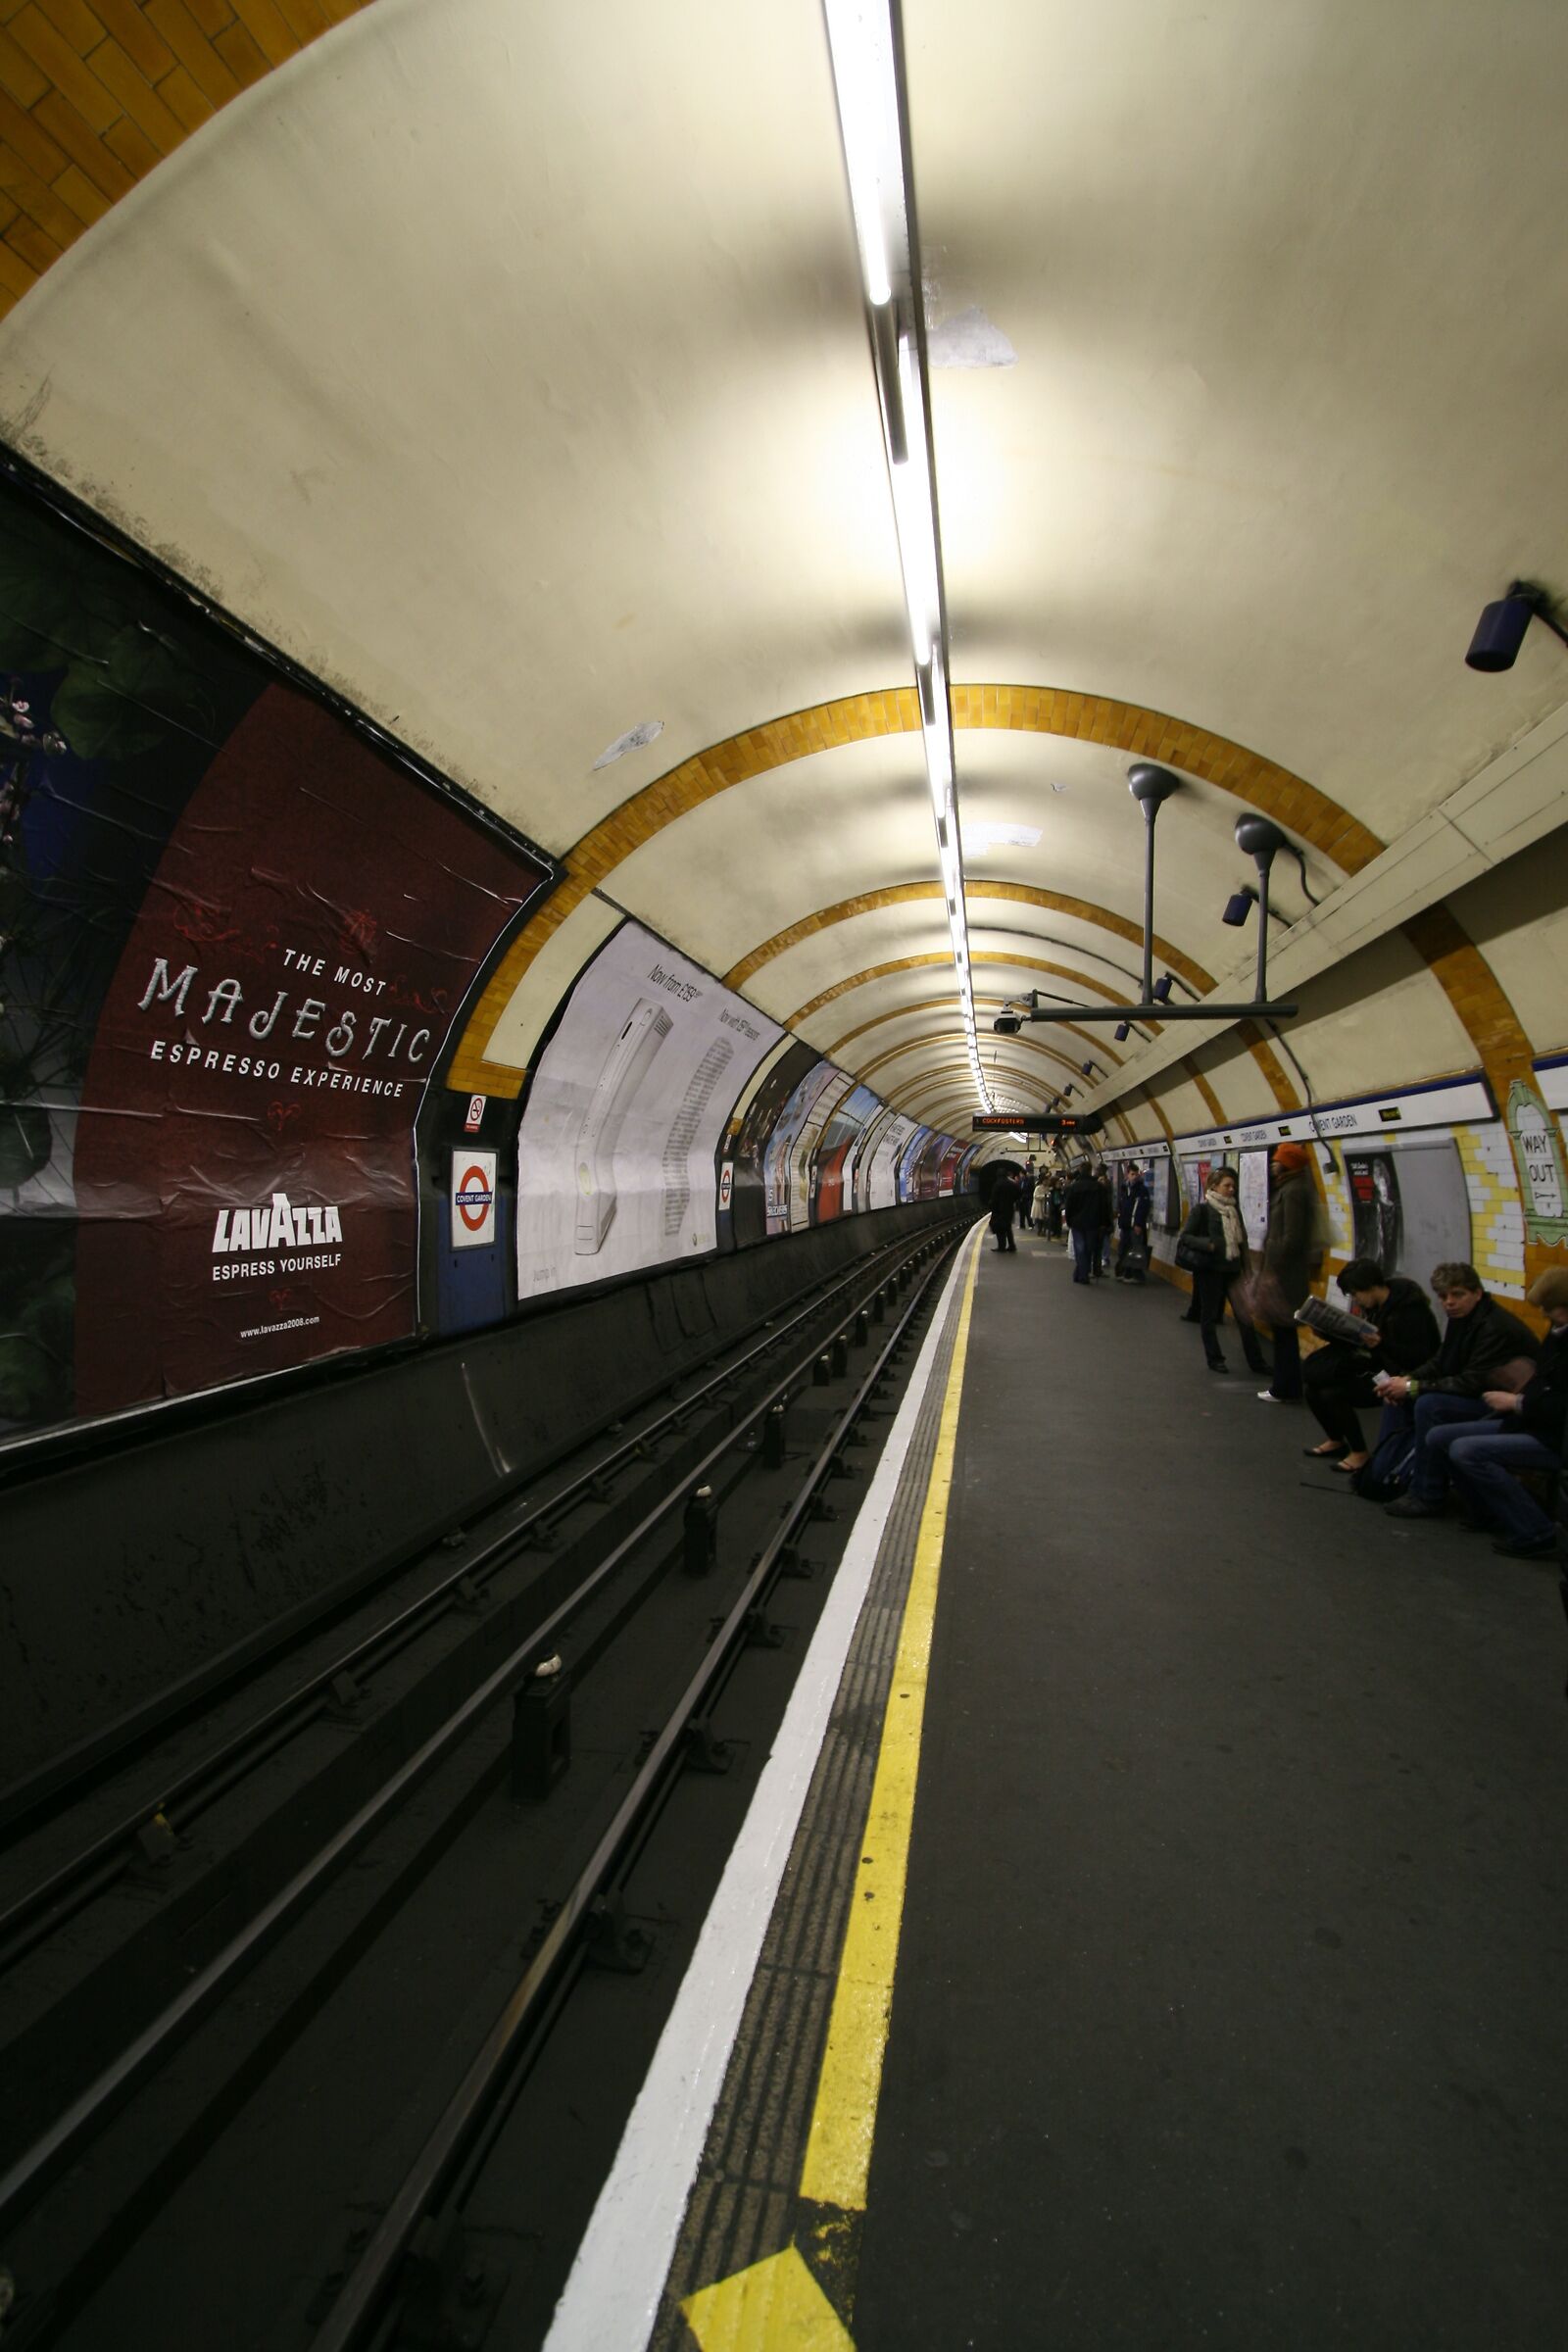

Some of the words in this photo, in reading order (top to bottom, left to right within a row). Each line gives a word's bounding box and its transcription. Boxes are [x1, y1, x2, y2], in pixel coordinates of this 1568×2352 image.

[282, 949, 325, 976] THE
[334, 966, 387, 996] MOST
[647, 964, 667, 985] Now
[137, 957, 430, 1063] MAJESTIC
[150, 1040, 281, 1079] ESPRESSO
[290, 1066, 404, 1098] EXPERIENCE
[1332, 1113, 1357, 1128] GARDEN
[1522, 1135, 1546, 1153] WAY
[1529, 1163, 1553, 1182] OUT
[457, 1195, 474, 1203] COVENT
[475, 1194, 492, 1202] GARDEN
[212, 1193, 343, 1252] LAVAZZA
[213, 1259, 275, 1281] ESPRESS
[280, 1253, 342, 1272] YOURSELF
[240, 1316, 320, 1339] www.lavazza2008.com
